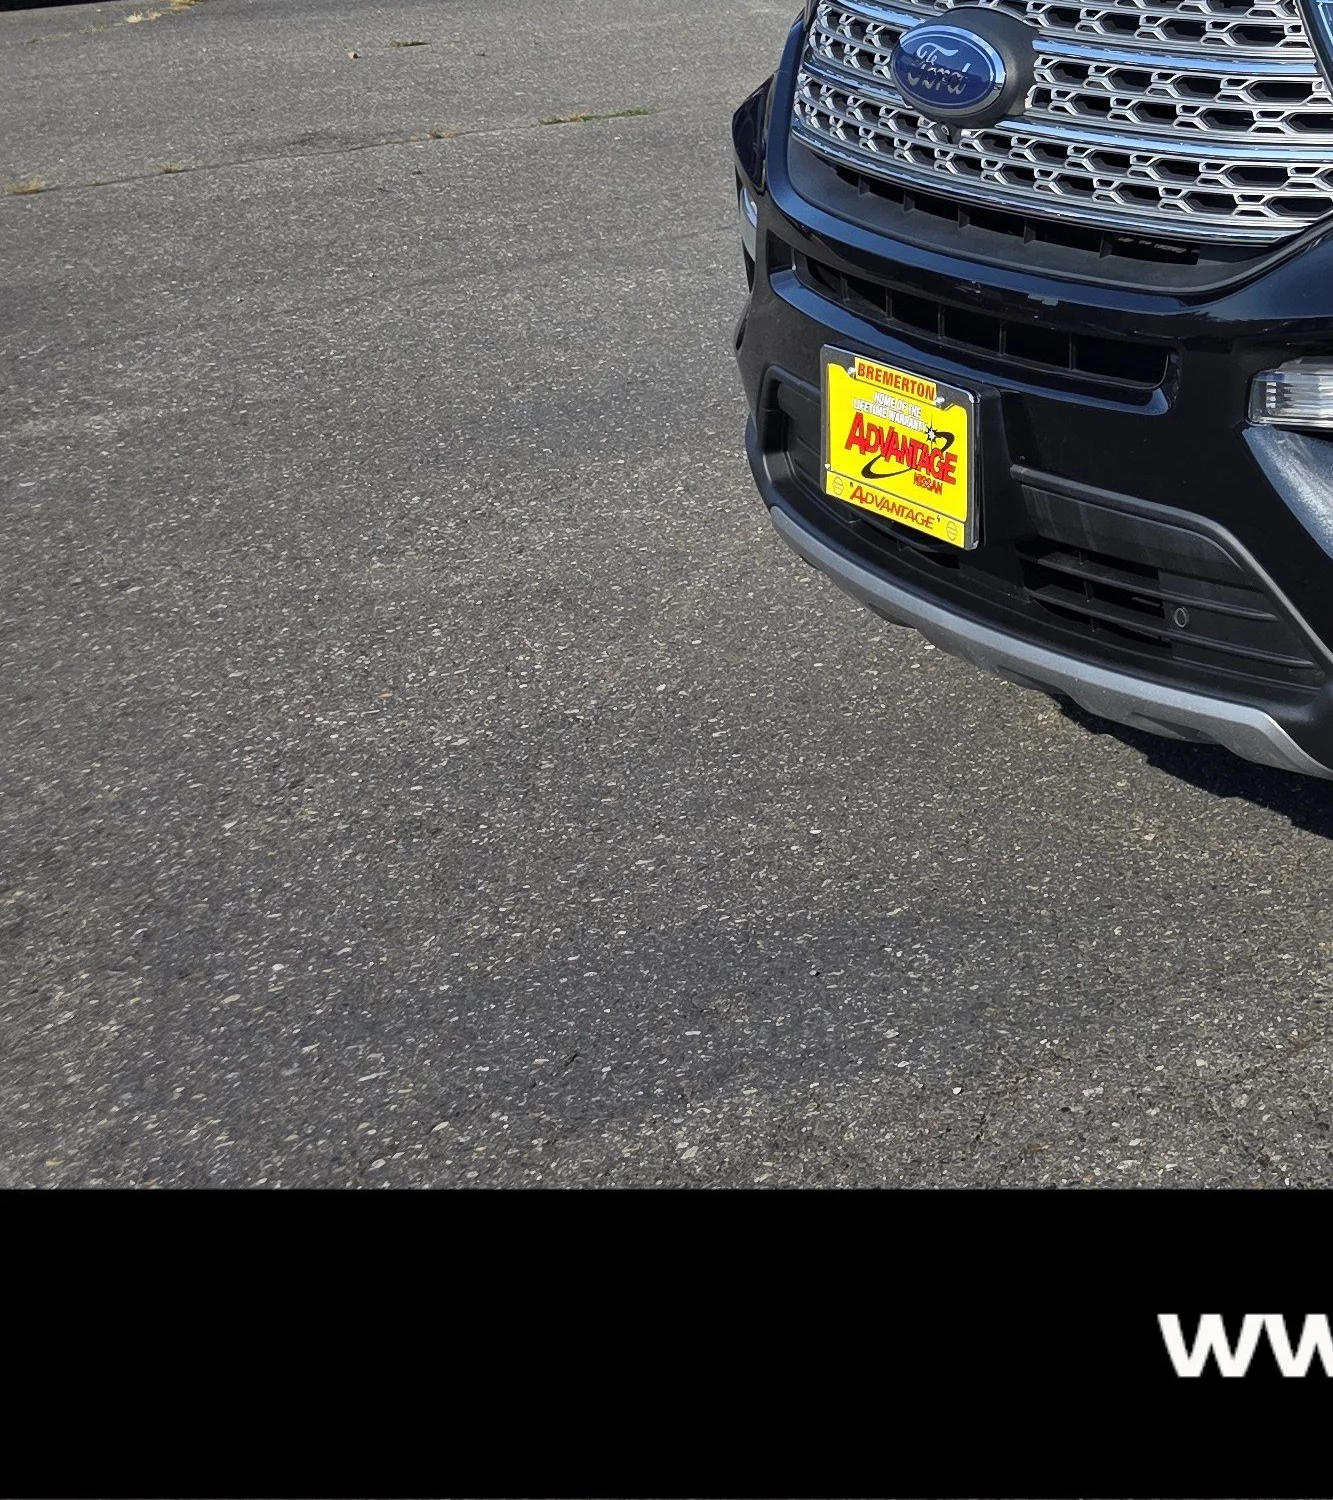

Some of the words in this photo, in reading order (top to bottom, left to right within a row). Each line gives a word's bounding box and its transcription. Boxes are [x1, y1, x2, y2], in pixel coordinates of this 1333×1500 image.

[857, 362, 936, 401] BREMERTON
[873, 391, 896, 409] HOME
[844, 411, 959, 486] ADVANTAGE
[850, 485, 936, 531] ADVANTAGE
